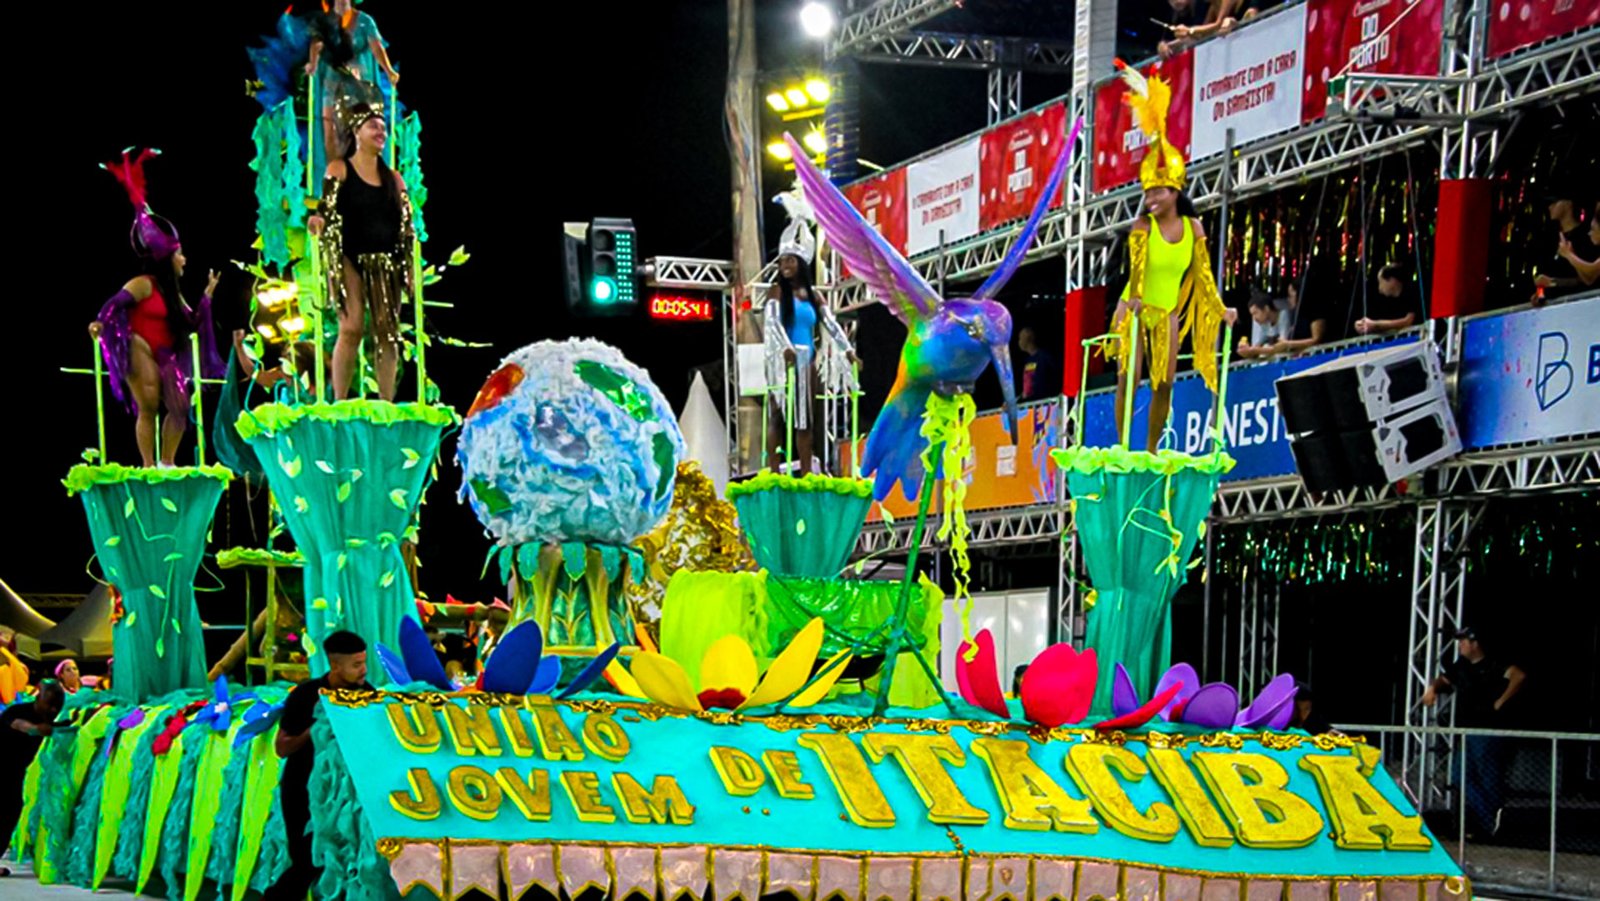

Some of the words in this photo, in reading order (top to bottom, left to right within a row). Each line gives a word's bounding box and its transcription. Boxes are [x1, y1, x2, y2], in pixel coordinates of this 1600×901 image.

[1349, 33, 1389, 72] PORTO
[1361, 12, 1378, 41] DO
[1207, 69, 1247, 99] CAMAROTE
[1248, 63, 1265, 84] COM
[1267, 58, 1273, 77] A
[1275, 50, 1296, 74] CARA
[1213, 101, 1225, 122] DO
[1185, 397, 1296, 454] BANEST
[387, 696, 631, 762] UNIÃO
[389, 765, 696, 825] JOVEM
[709, 745, 815, 800] DE
[798, 732, 1432, 851] ITACIBÁ
